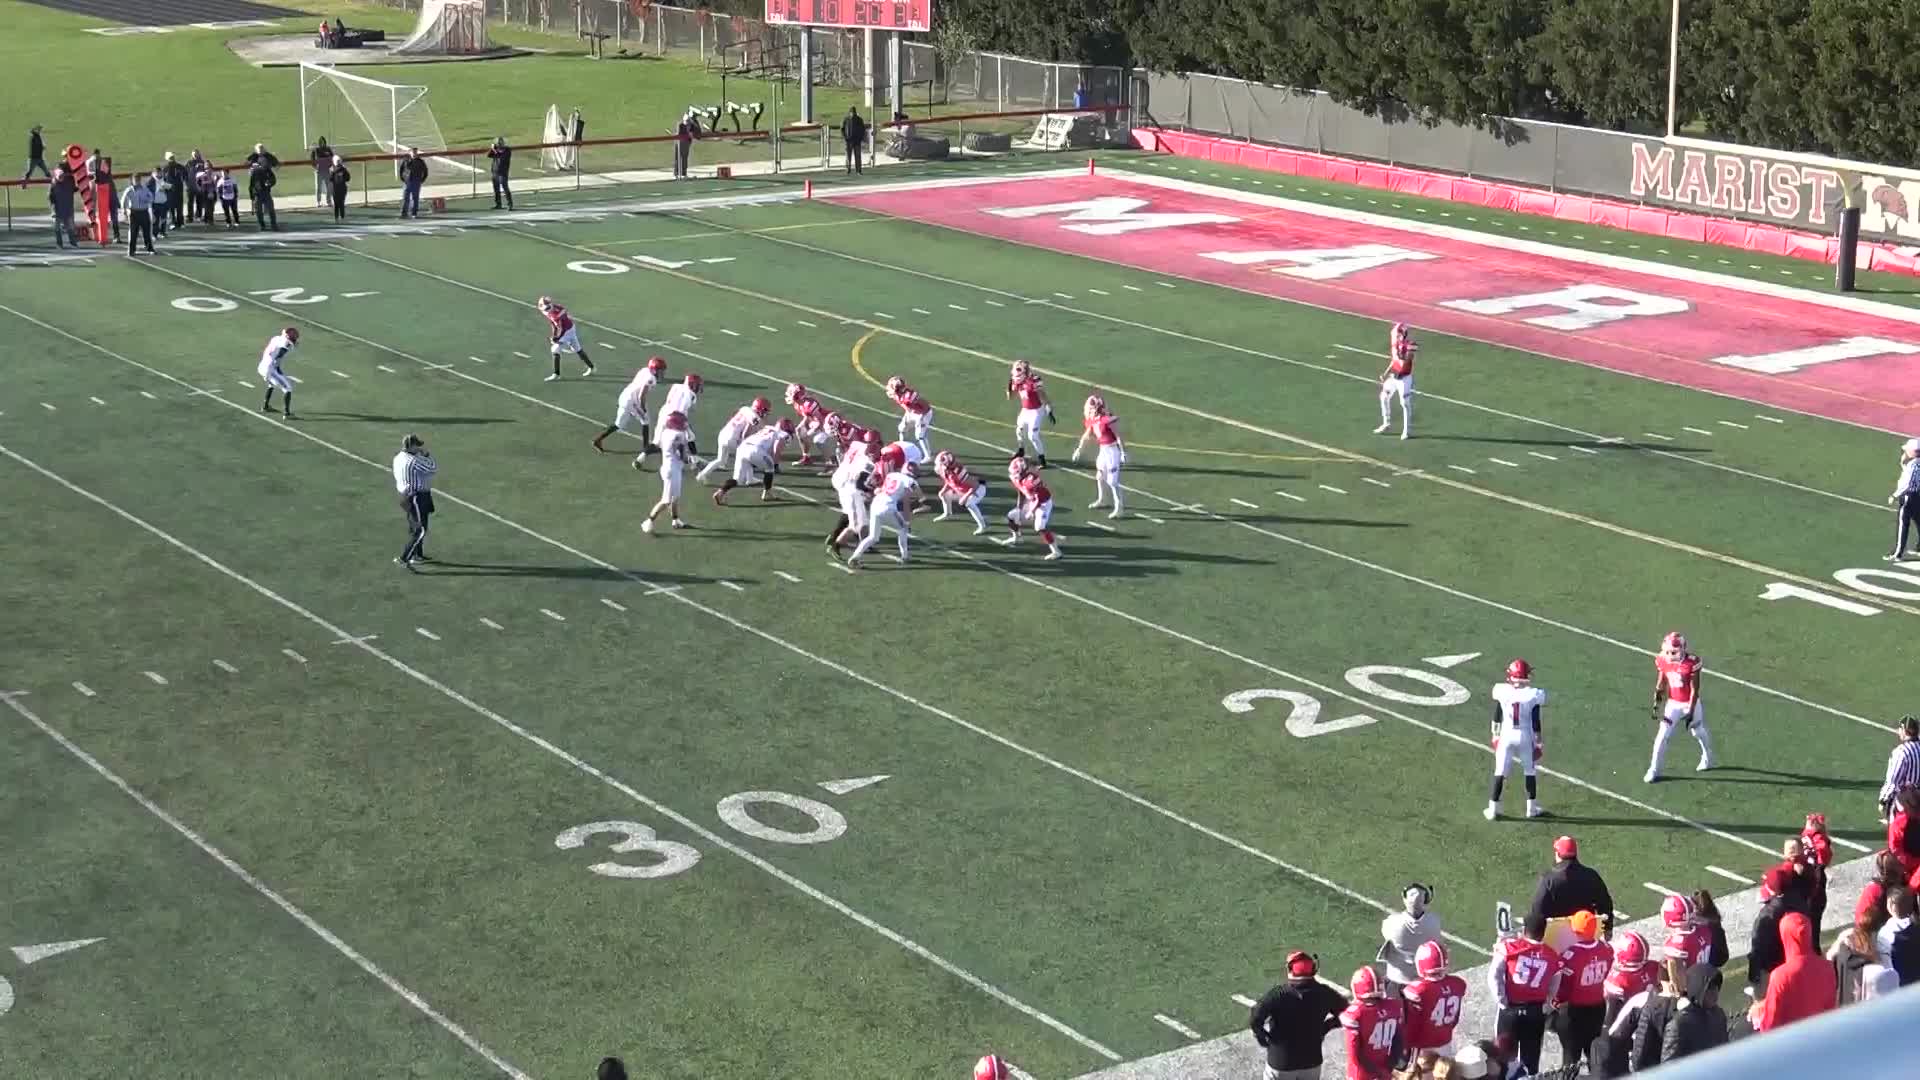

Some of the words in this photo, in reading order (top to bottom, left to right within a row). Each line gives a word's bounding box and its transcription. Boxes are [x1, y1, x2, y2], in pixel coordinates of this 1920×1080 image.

[1630, 142, 1837, 224] MARIST
[1222, 665, 1471, 738] 20
[1510, 701, 1520, 729] 1
[555, 791, 847, 878] 30
[1512, 956, 1547, 988] 57
[1430, 995, 1460, 1027] 43
